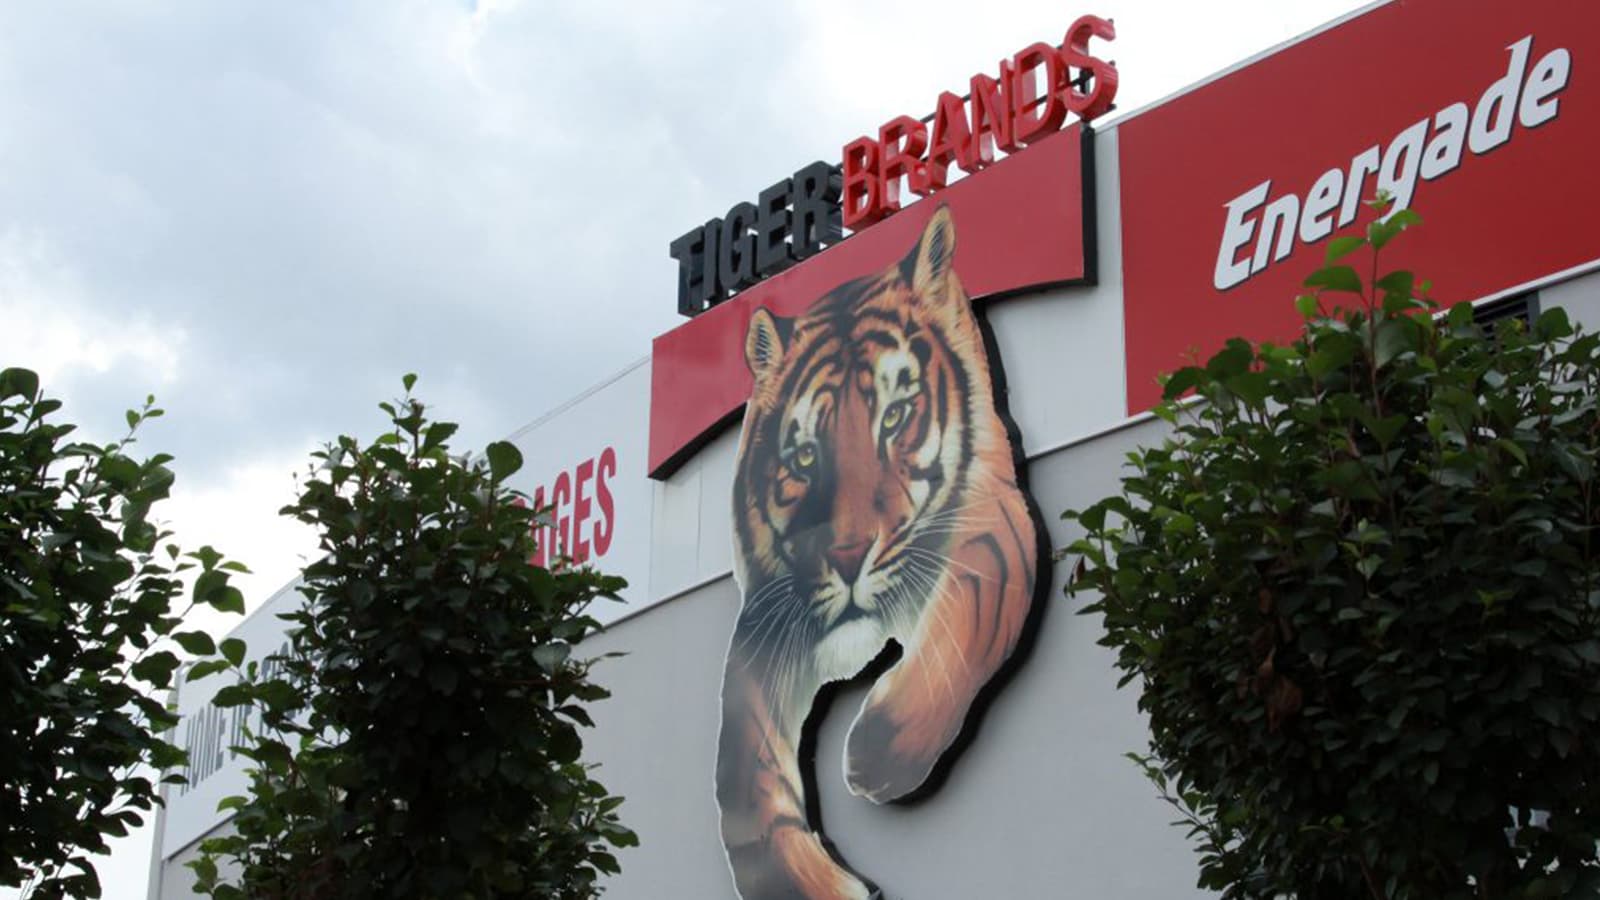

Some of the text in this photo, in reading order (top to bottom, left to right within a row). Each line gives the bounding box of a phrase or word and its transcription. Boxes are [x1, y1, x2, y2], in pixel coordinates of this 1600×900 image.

[670, 14, 1118, 317] TIGER BRANDS
[1213, 34, 1572, 291] Energade
[512, 446, 617, 576] AGES
